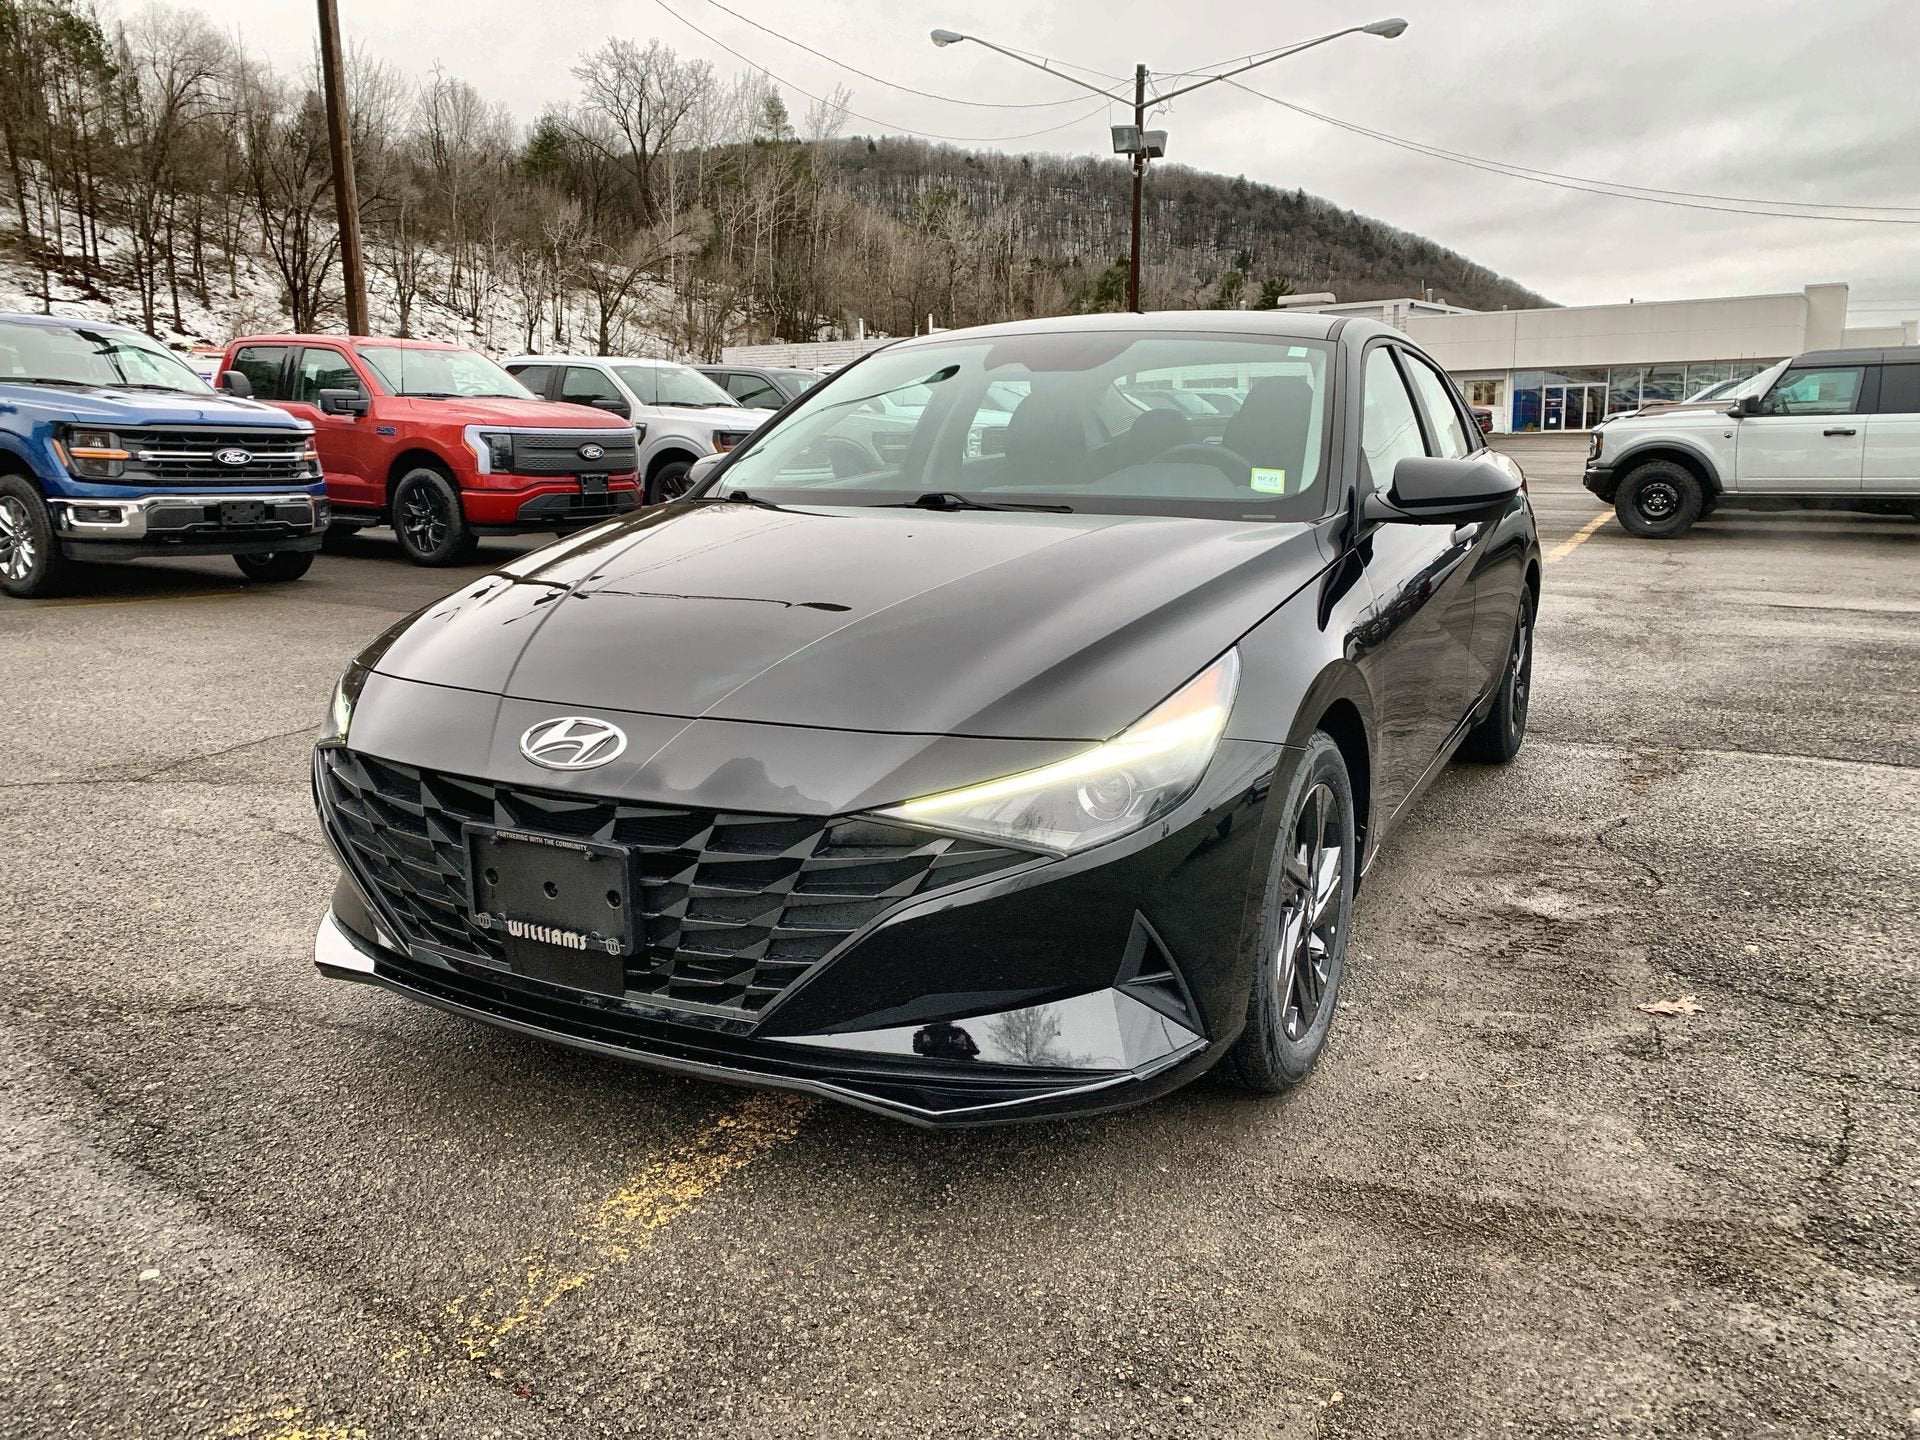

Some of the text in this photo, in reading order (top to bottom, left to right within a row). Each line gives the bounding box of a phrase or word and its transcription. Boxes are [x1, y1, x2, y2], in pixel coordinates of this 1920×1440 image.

[224, 451, 246, 462] Ford
[496, 830, 588, 851] PARTNERING WITH THE COMMUNITY
[507, 920, 587, 950] WILLIAMS
